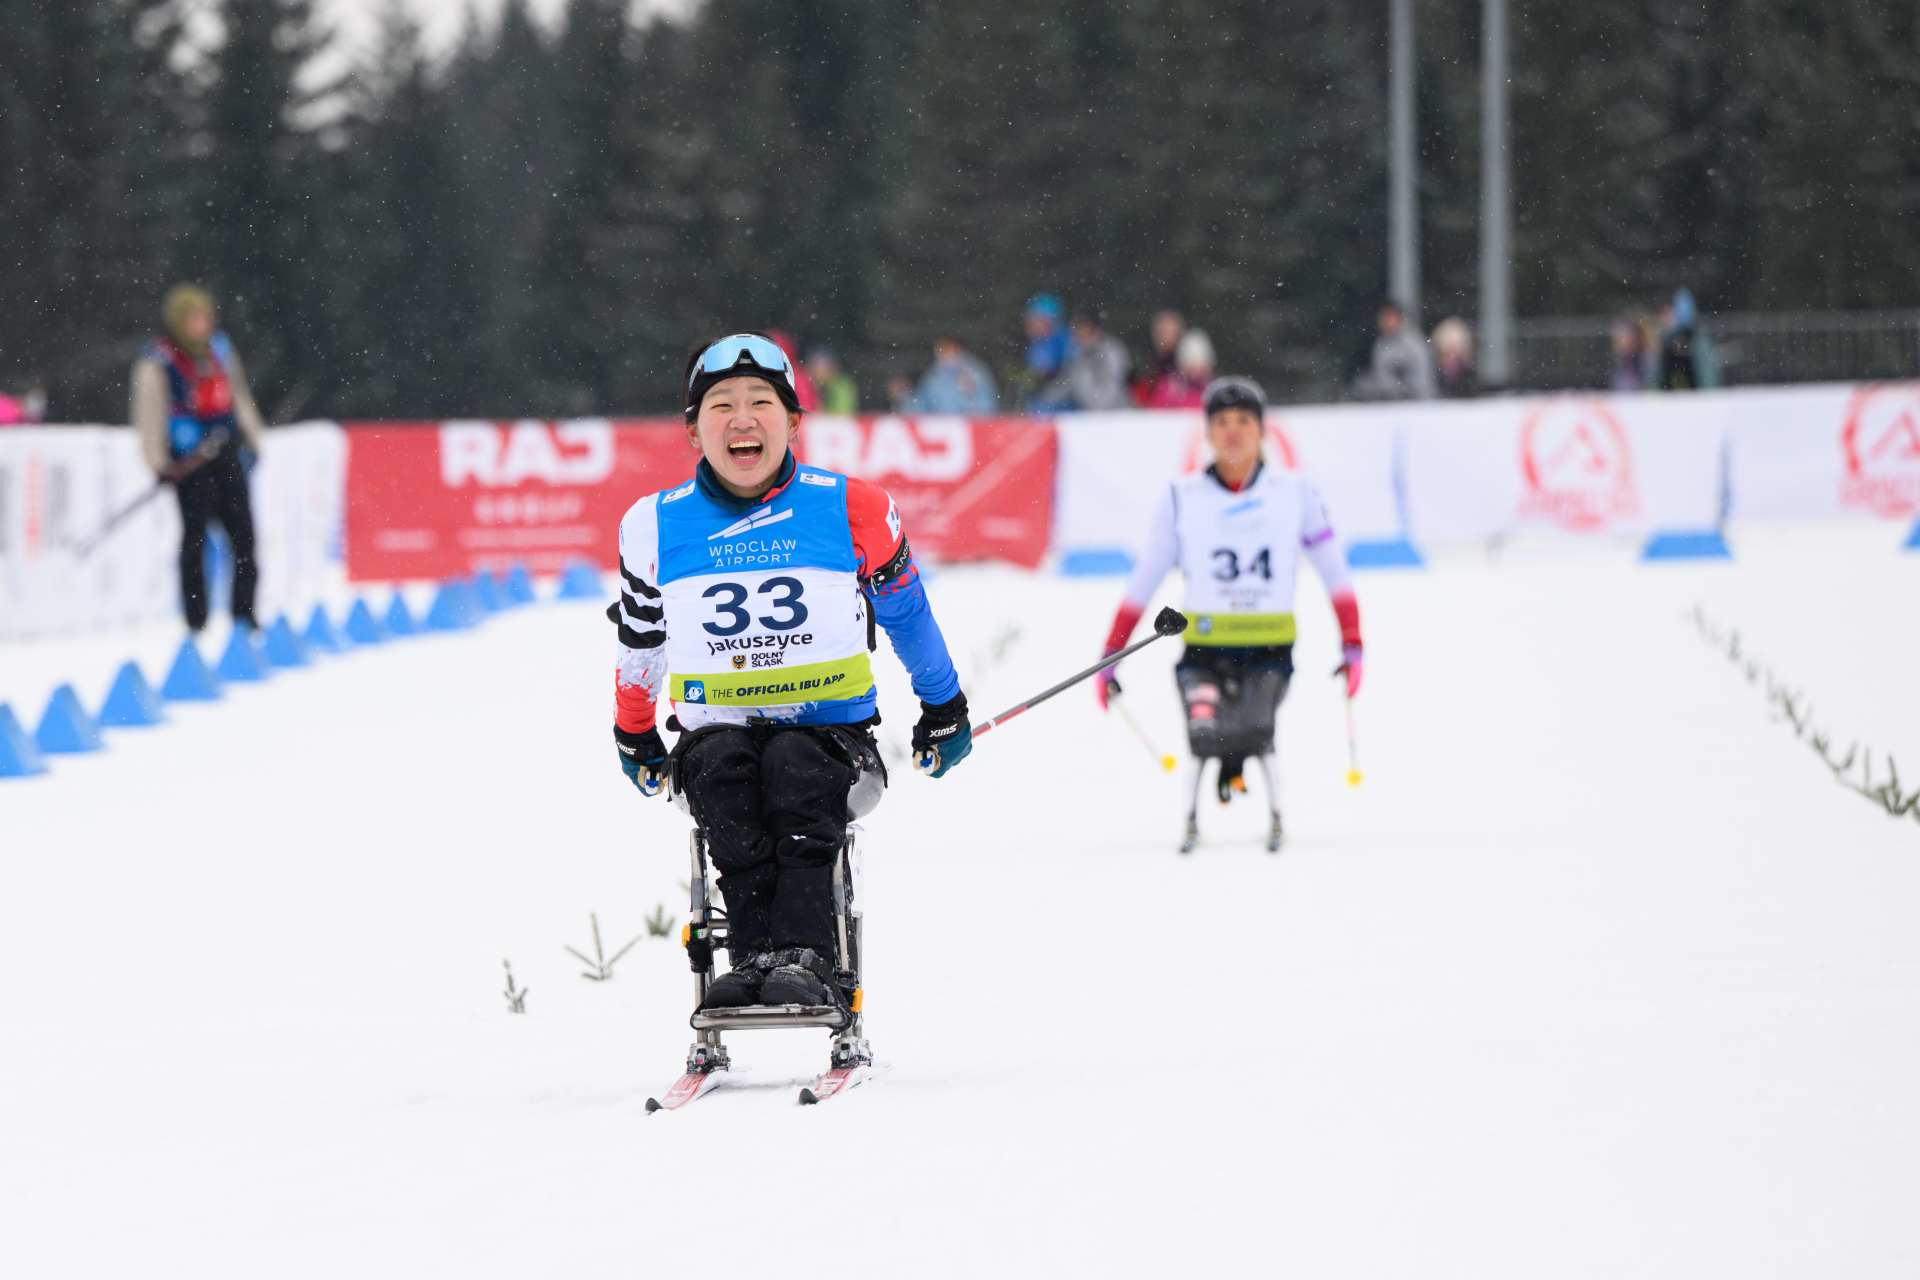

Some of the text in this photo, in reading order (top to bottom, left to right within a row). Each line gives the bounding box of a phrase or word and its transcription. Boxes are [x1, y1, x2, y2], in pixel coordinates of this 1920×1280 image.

[709, 539, 796, 557] WROCLAW
[715, 553, 792, 568] AIRPORT
[1211, 547, 1273, 582] 34
[701, 576, 808, 636] 33
[751, 651, 784, 661] DOLNY
[712, 673, 845, 698] THE OFFICIAL IBU APP
